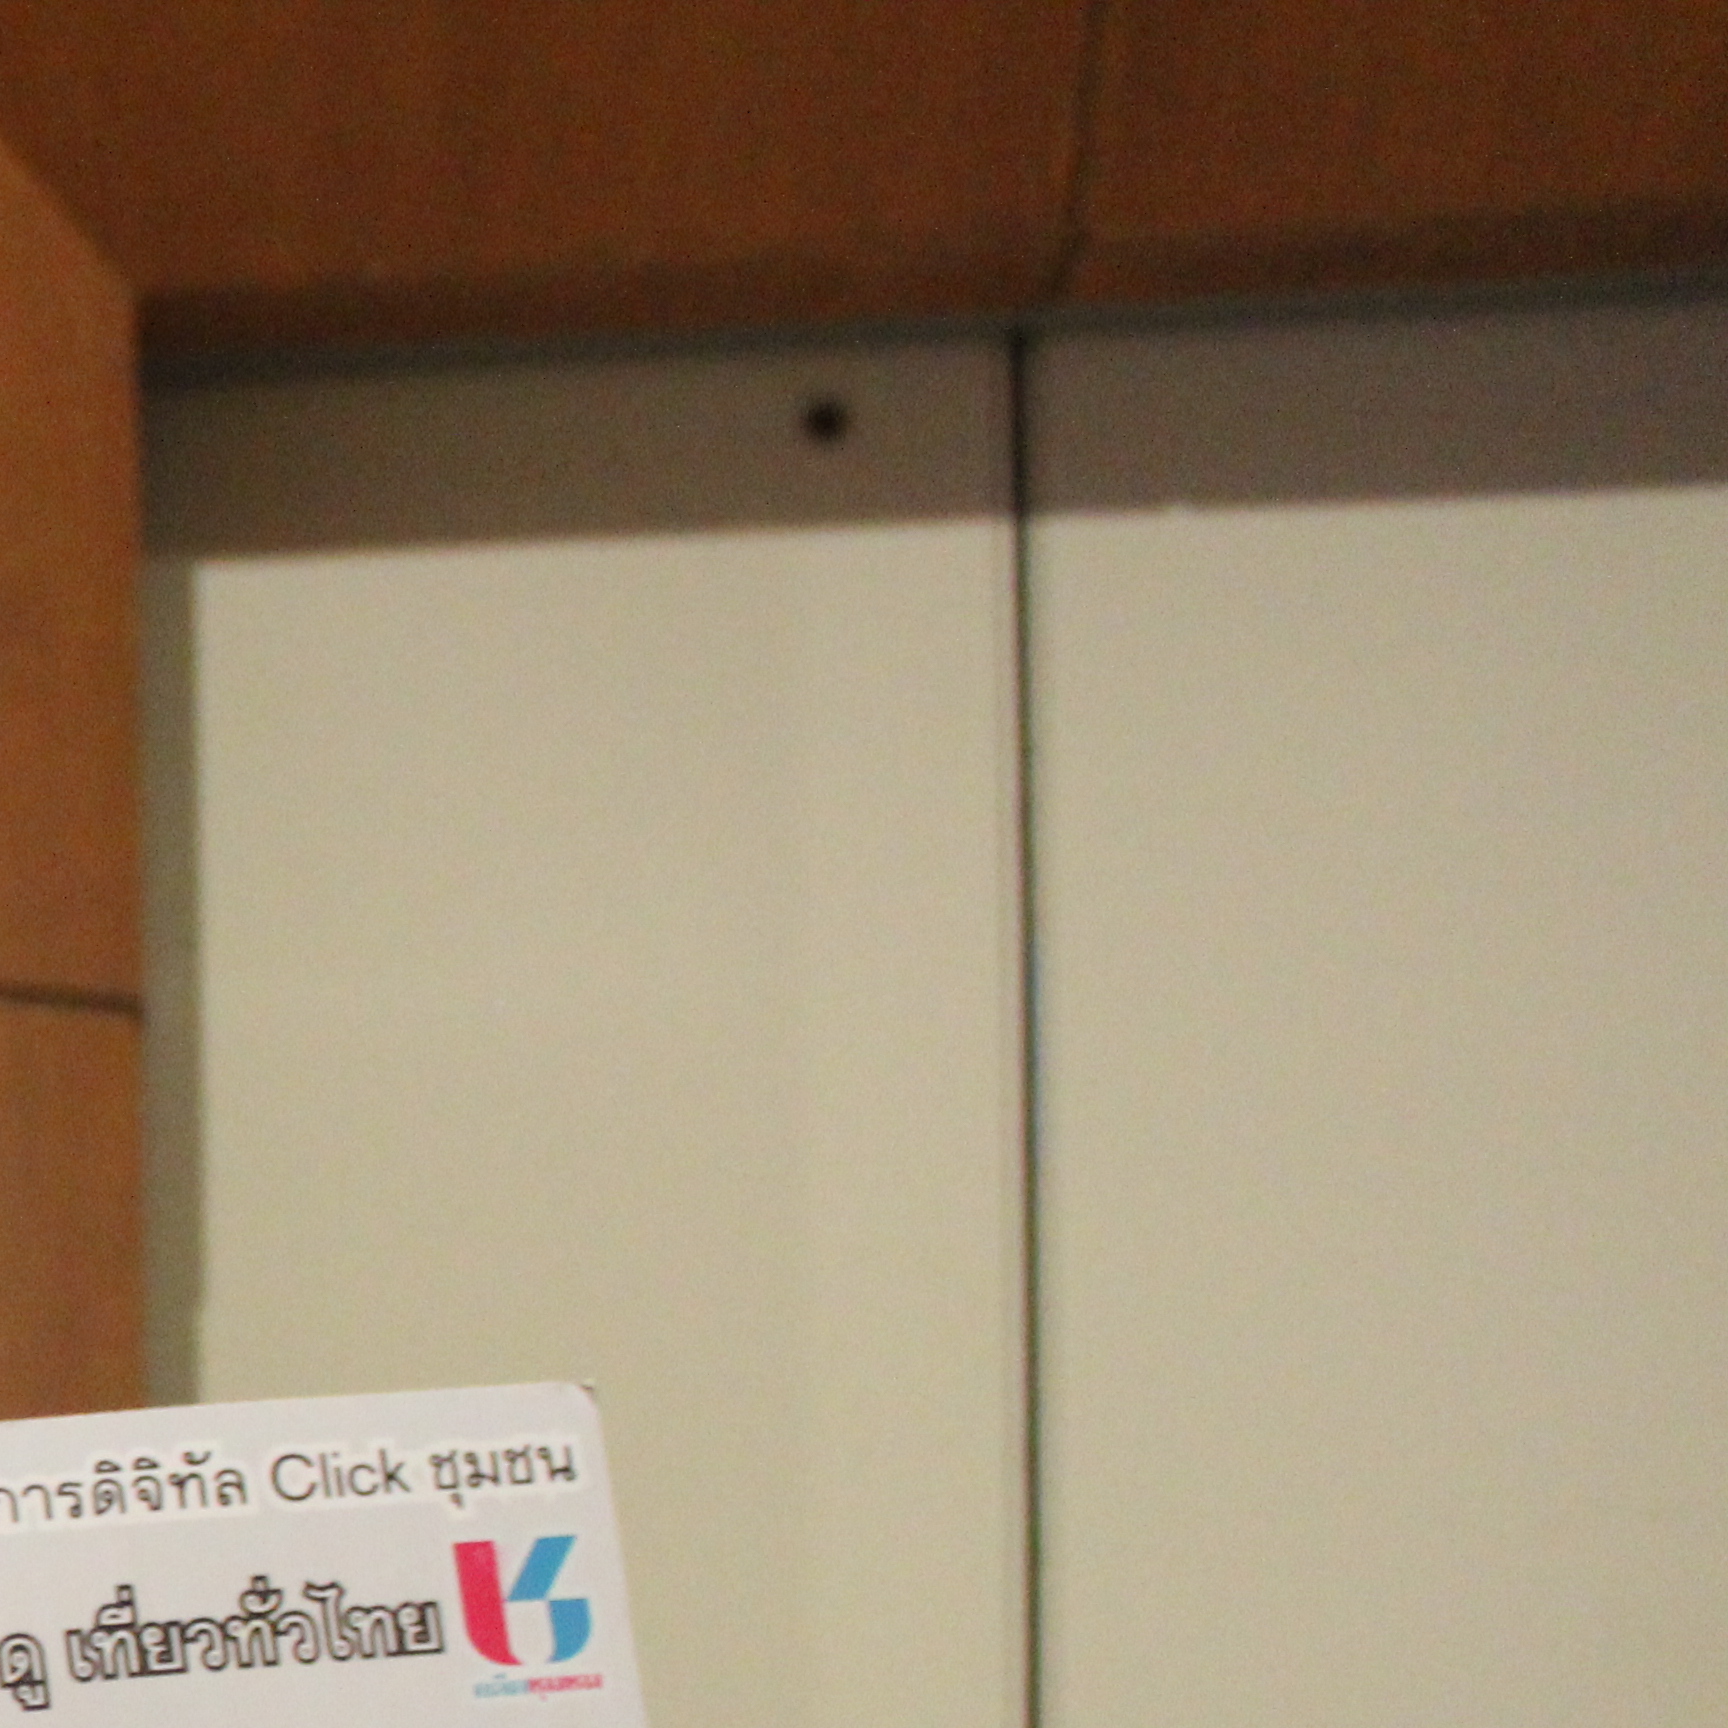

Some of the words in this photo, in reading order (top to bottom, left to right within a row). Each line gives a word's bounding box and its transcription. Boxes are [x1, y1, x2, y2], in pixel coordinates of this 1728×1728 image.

[270, 1448, 411, 1502] Click
[429, 1443, 578, 1510] ชุมชน
[64, 1574, 446, 1682] เที่ยวทั่วไทย
